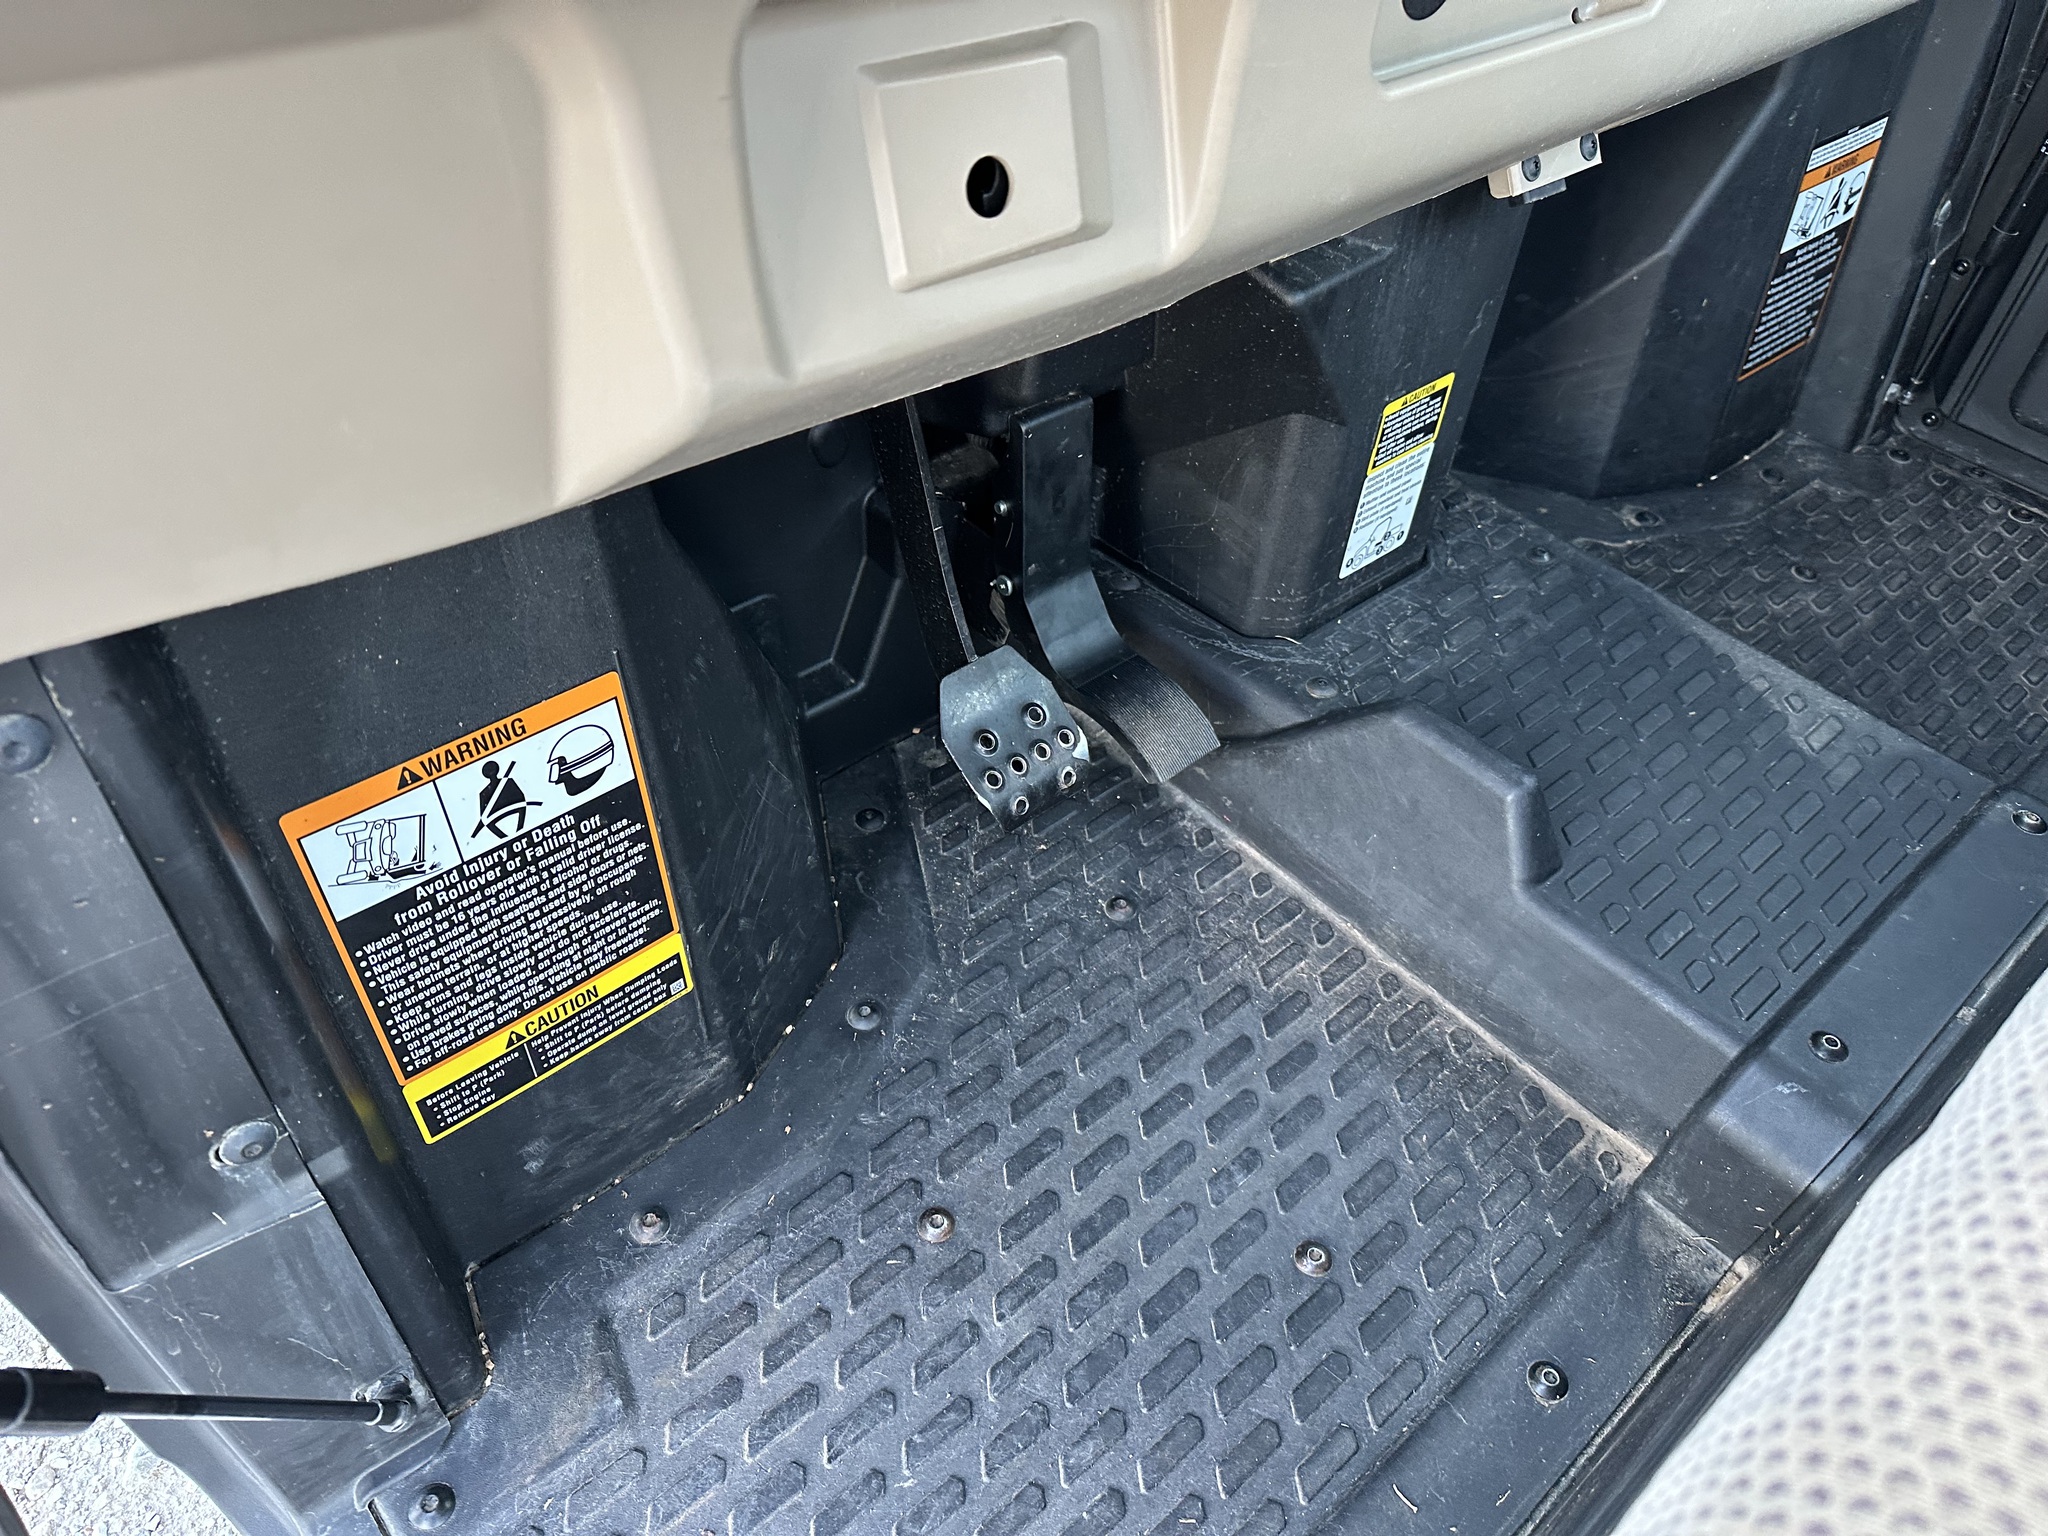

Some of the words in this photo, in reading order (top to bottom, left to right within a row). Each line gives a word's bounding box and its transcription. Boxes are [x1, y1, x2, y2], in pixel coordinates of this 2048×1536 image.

[1409, 383, 1437, 403] CAUTION
[419, 717, 527, 778] WARNING
[362, 932, 401, 955] Watch
[401, 916, 433, 937] video
[434, 903, 456, 921] and
[456, 890, 483, 910] read
[483, 864, 537, 897] operator's
[537, 843, 576, 870] manual
[576, 827, 609, 850] before
[610, 818, 632, 833] use.
[367, 942, 404, 966] Driver
[405, 927, 435, 948] must
[434, 920, 450, 933] be
[450, 911, 466, 924] 16
[466, 896, 498, 919] years
[498, 885, 516, 901] old
[516, 874, 540, 892] with
[541, 870, 549, 880] a
[549, 854, 576, 875] valid
[576, 840, 606, 861] driver
[606, 822, 646, 846] license.
[372, 953, 406, 976] Never
[408, 939, 437, 959] drive
[438, 921, 470, 944] under
[469, 912, 489, 927] the
[489, 887, 539, 917] influence
[539, 878, 551, 892] of
[552, 859, 589, 886] alcohol
[590, 854, 601, 866] or
[602, 839, 633, 859] drugs.
[375, 960, 418, 985] Vehicle
[417, 954, 430, 966] is
[430, 928, 479, 959] equipped
[478, 917, 502, 934] with
[501, 894, 547, 923] seatbelts
[547, 882, 567, 899] and
[566, 873, 588, 889] side
[588, 858, 616, 878] doors
[615, 852, 626, 863] or
[627, 842, 650, 858] nets.
[393, 900, 433, 926] from
[435, 865, 502, 906] Rollover
[505, 855, 522, 872] or
[524, 829, 577, 862] Falling
[579, 814, 601, 834] Off
[415, 868, 460, 901] Avoid
[462, 847, 508, 877] Injury
[512, 837, 528, 853] or
[531, 814, 576, 844] Death
[380, 978, 407, 995] This
[407, 960, 441, 982] safety
[442, 929, 499, 965] equipment
[499, 915, 527, 936] must
[526, 909, 541, 921] be
[542, 893, 567, 913] used
[567, 887, 580, 900] by
[581, 878, 596, 892] all
[596, 854, 647, 885] occupants.
[384, 984, 415, 1005] Wear
[416, 962, 461, 990] helmets
[461, 946, 491, 966] when
[492, 926, 529, 951] driving
[529, 893, 594, 931] aggressively,
[595, 884, 609, 896] on
[609, 868, 637, 889] rough
[390, 1002, 402, 1014] or
[404, 982, 444, 1007] uneven
[444, 963, 485, 986] terrain,
[486, 953, 498, 965] or
[499, 946, 511, 958] at
[511, 928, 544, 952] higher
[545, 909, 584, 934] speeds.
[393, 1004, 423, 1024] Keep
[424, 989, 452, 1009] arms
[453, 976, 474, 994] and
[474, 965, 498, 983] legs
[498, 948, 531, 970] inside
[531, 928, 568, 952] vehicle
[568, 910, 600, 932] during
[600, 900, 622, 915] use.
[397, 1012, 431, 1033] While
[431, 991, 474, 1016] turning,
[475, 974, 502, 993] drive
[502, 955, 535, 978] slowly
[536, 943, 556, 960] and
[557, 937, 571, 949] do
[571, 926, 588, 942] not
[588, 900, 641, 932] accelerate.
[401, 1022, 432, 1042] Drive
[432, 1003, 467, 1027] slowly
[467, 988, 497, 1007] when
[497, 967, 536, 992] loaded,
[537, 958, 551, 970] on
[551, 942, 581, 963] rough
[581, 935, 592, 946] or
[593, 916, 627, 940] uneven
[627, 898, 662, 920] terrain,
[406, 1039, 421, 1051] on
[421, 1021, 453, 1046] paved
[453, 1000, 499, 1027] surfaces,
[498, 983, 527, 1002] while
[527, 958, 572, 987] operating
[571, 950, 583, 963] at
[582, 937, 607, 957] night
[606, 932, 617, 943] or
[617, 926, 628, 937] in
[628, 908, 664, 931] reverse.
[409, 1045, 432, 1060] Use
[431, 1026, 467, 1049] brakes
[466, 1010, 495, 1032] going
[495, 995, 523, 1015] down
[522, 982, 548, 1000] hills.
[547, 962, 583, 985] Vehicle
[583, 949, 603, 966] may
[603, 924, 651, 955] freewheel.
[413, 1054, 432, 1069] For
[434, 1029, 476, 1059] off-road
[476, 1021, 496, 1036] use
[496, 1008, 522, 1025] only.
[522, 998, 538, 1011] Do
[538, 986, 556, 1002] not
[555, 977, 574, 992] use
[574, 969, 588, 981] on
[588, 952, 618, 975] public
[618, 937, 648, 957] roads.
[524, 984, 599, 1037] CAUTION
[530, 1034, 550, 1048] Help
[550, 1016, 580, 1037] Prevent
[579, 1003, 602, 1020] Injury
[602, 990, 624, 1006] When
[624, 971, 656, 994] Dumping
[656, 958, 678, 975] Loads
[543, 1035, 564, 1050] Shift
[564, 1030, 573, 1039] to
[573, 1025, 580, 1033] P
[581, 1011, 605, 1030] (Park)
[605, 997, 630, 1015] before
[630, 978, 662, 1000] dumping
[425, 1088, 454, 1107] Before
[454, 1069, 488, 1091] Leaving
[488, 1051, 520, 1072] Vehicle
[439, 1093, 461, 1109] Shift
[461, 1089, 471, 1098] to
[471, 1083, 478, 1092] P
[479, 1069, 505, 1088] (Park)
[442, 1103, 463, 1117] Stop
[463, 1086, 492, 1106] Engine
[446, 1102, 480, 1125] Remove
[480, 1093, 496, 1105] Key
